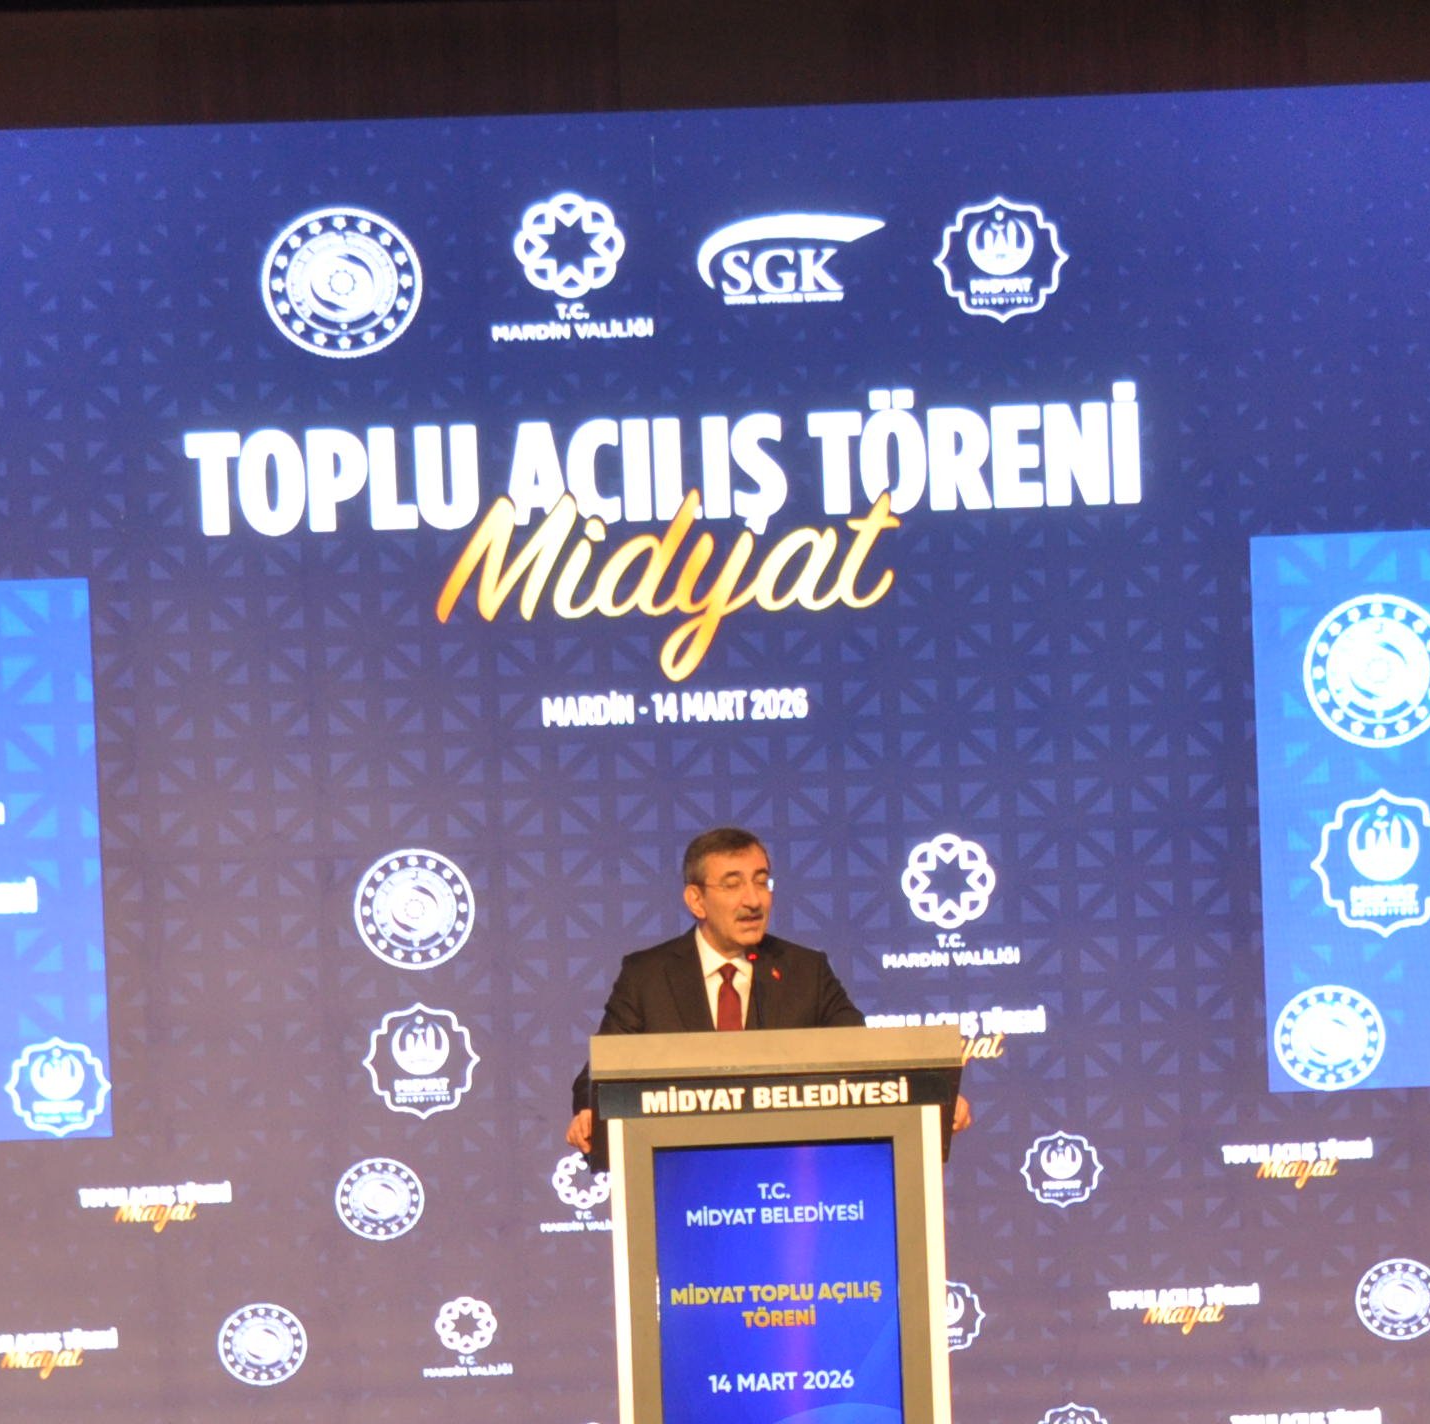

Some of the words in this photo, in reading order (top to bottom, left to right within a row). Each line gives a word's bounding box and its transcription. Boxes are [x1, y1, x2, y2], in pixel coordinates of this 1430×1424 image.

[721, 247, 844, 296] SGK
[555, 303, 590, 320] T.C.
[491, 321, 571, 342] MARDİN
[574, 317, 655, 340] VALİLİĞİ
[183, 423, 481, 538] TOPLU
[507, 411, 789, 533] AÇILIŞ
[807, 381, 1142, 516] TÖRENİ
[435, 486, 902, 683] Midyat
[541, 690, 635, 728] MARDİN
[651, 692, 679, 724] 14
[681, 690, 748, 723] MART
[750, 687, 809, 721] 2026
[641, 1086, 745, 1114] MİDYAT
[752, 1076, 909, 1109] BELEDİYESİ
[758, 1183, 791, 1200] T.C.
[686, 1206, 756, 1227] MİDYAT
[760, 1200, 864, 1224] BELEDİYESİ
[670, 1283, 746, 1306] MİDYAT
[749, 1285, 814, 1302] TOPLU
[817, 1280, 882, 1303] AÇILIŞ
[742, 1305, 817, 1328] TÖRENİ
[708, 1374, 732, 1394] 14
[736, 1372, 798, 1393] MART
[802, 1369, 855, 1391] 2026
